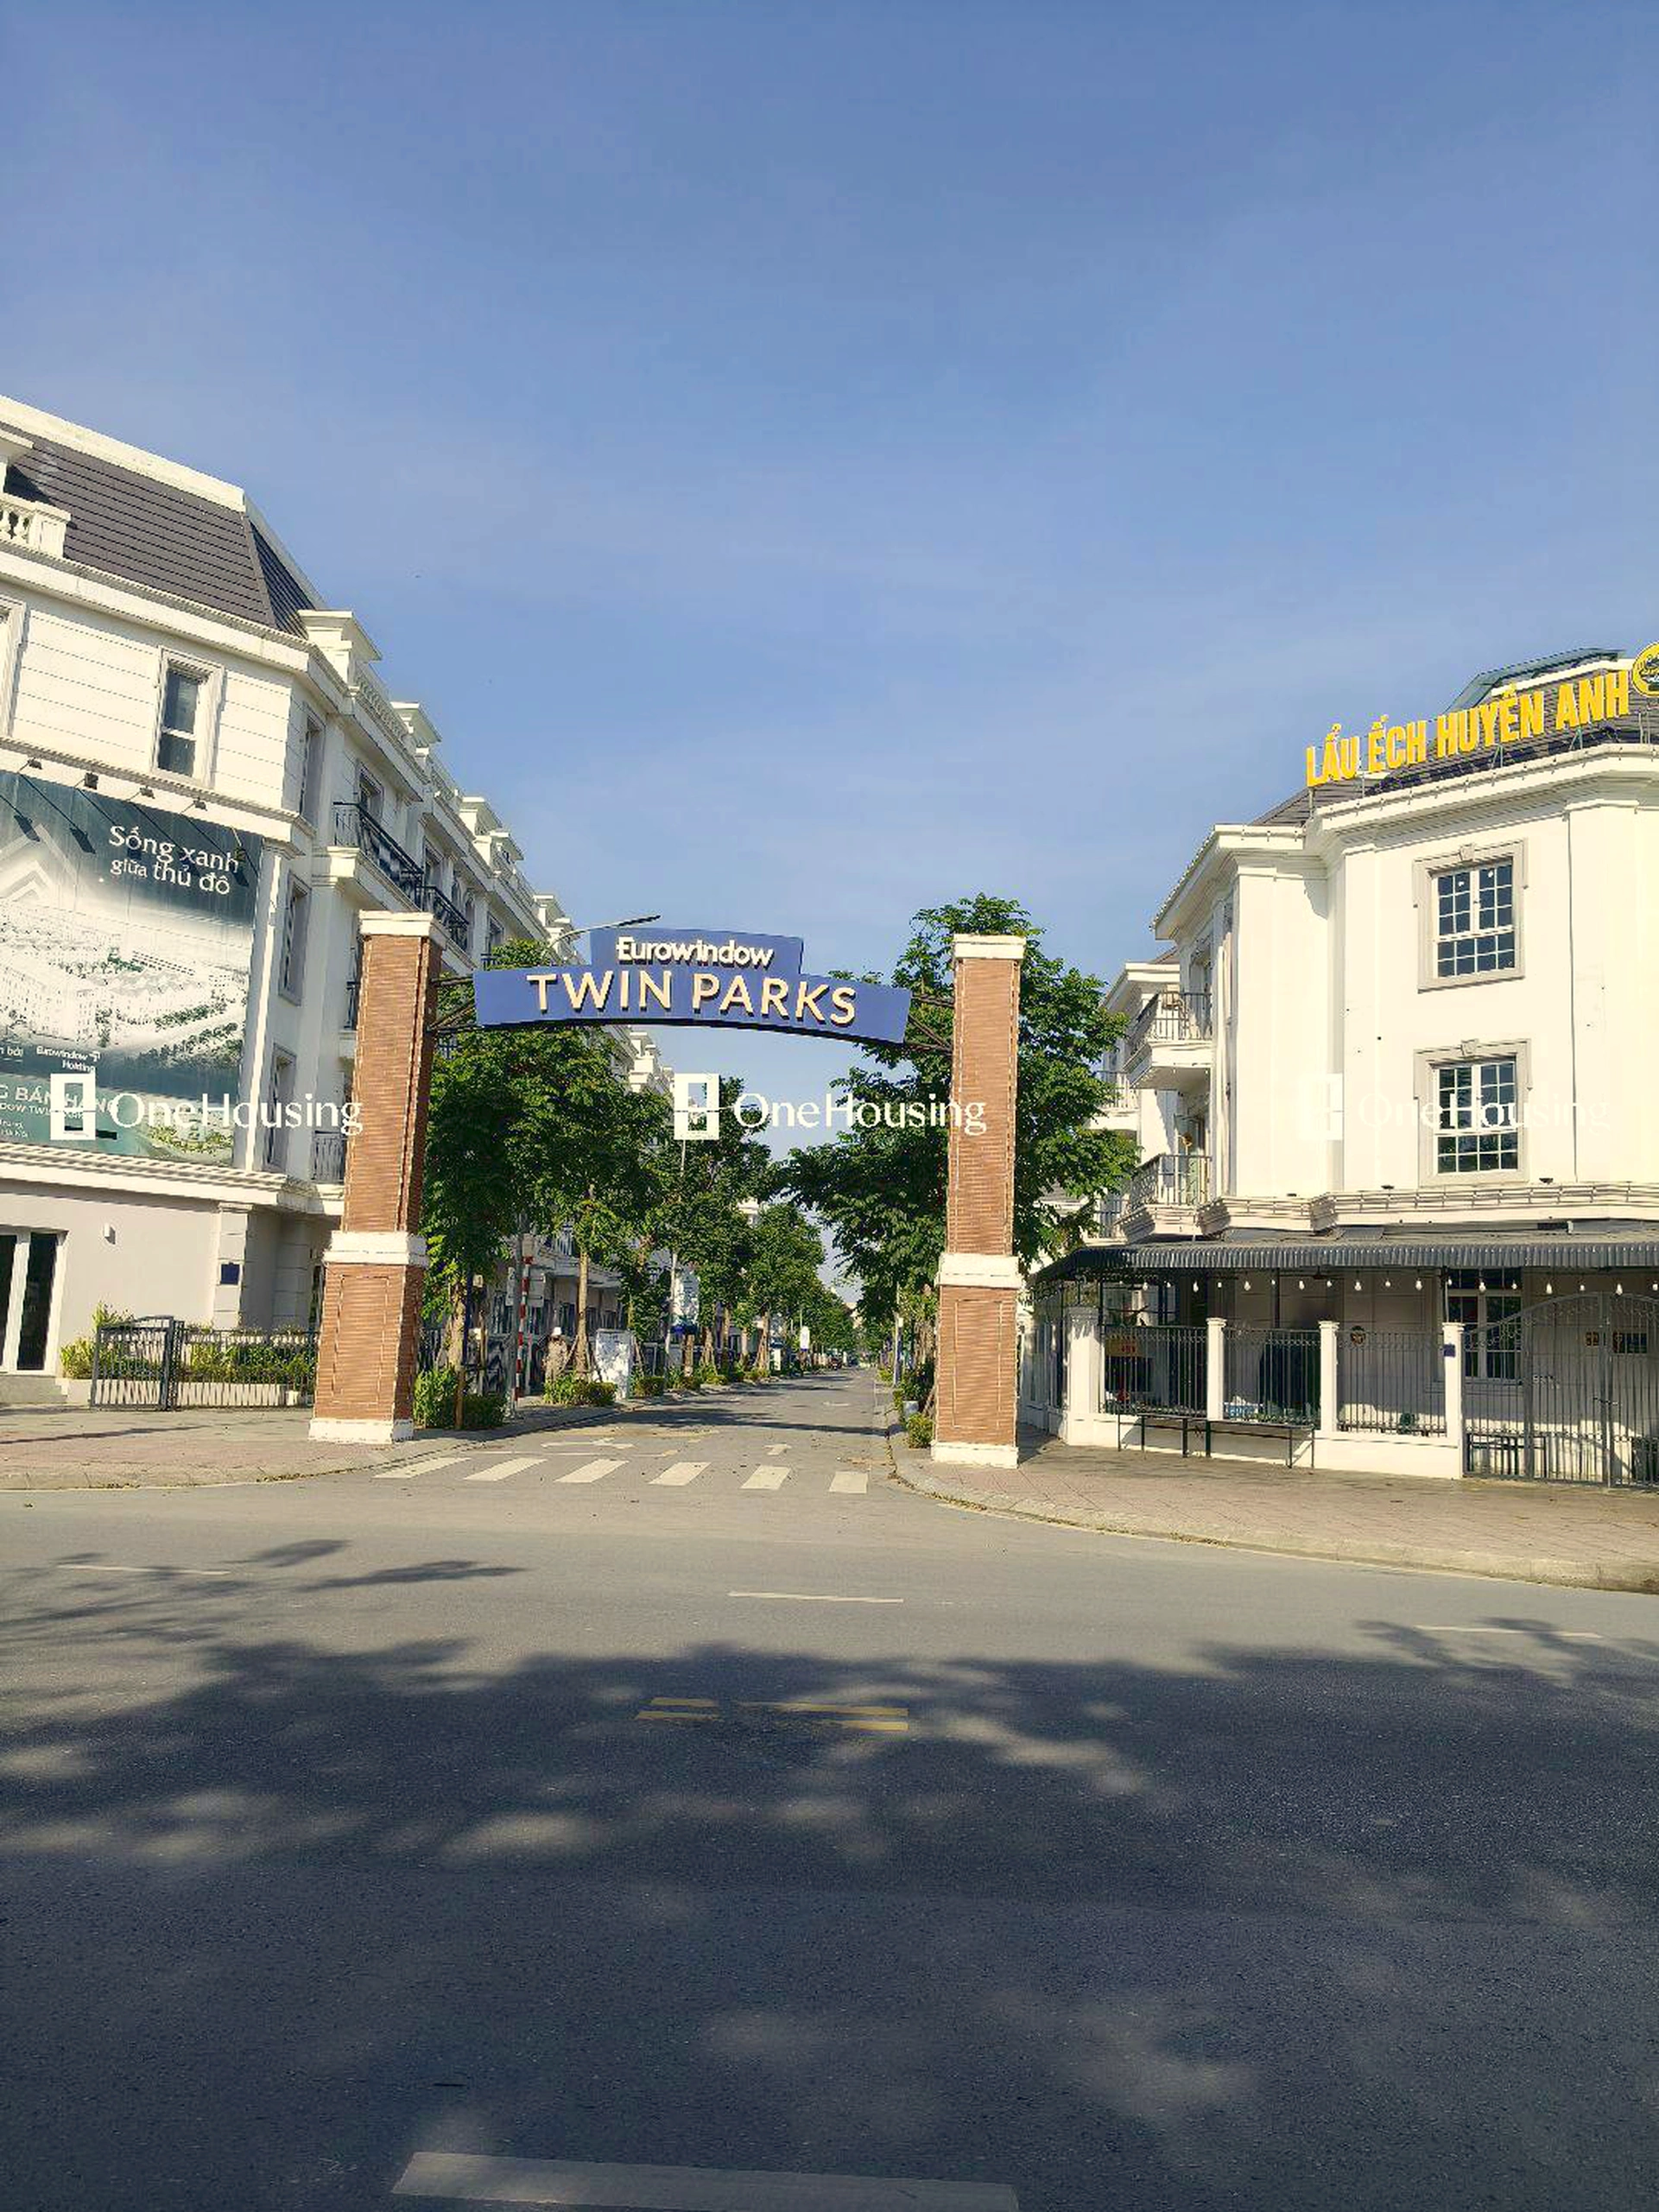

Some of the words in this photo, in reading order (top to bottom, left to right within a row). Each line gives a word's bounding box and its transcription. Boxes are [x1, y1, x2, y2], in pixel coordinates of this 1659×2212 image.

[1368, 714, 1428, 774] ẾCH
[1555, 670, 1631, 731] ANH
[109, 825, 175, 864] Sống
[180, 847, 238, 873] xanh
[110, 859, 148, 878] giữa
[153, 861, 192, 887] thủ
[199, 871, 231, 895] đô
[616, 936, 775, 967] Eurowindow
[526, 970, 672, 1011] TWIN
[692, 973, 857, 1026] PARKS
